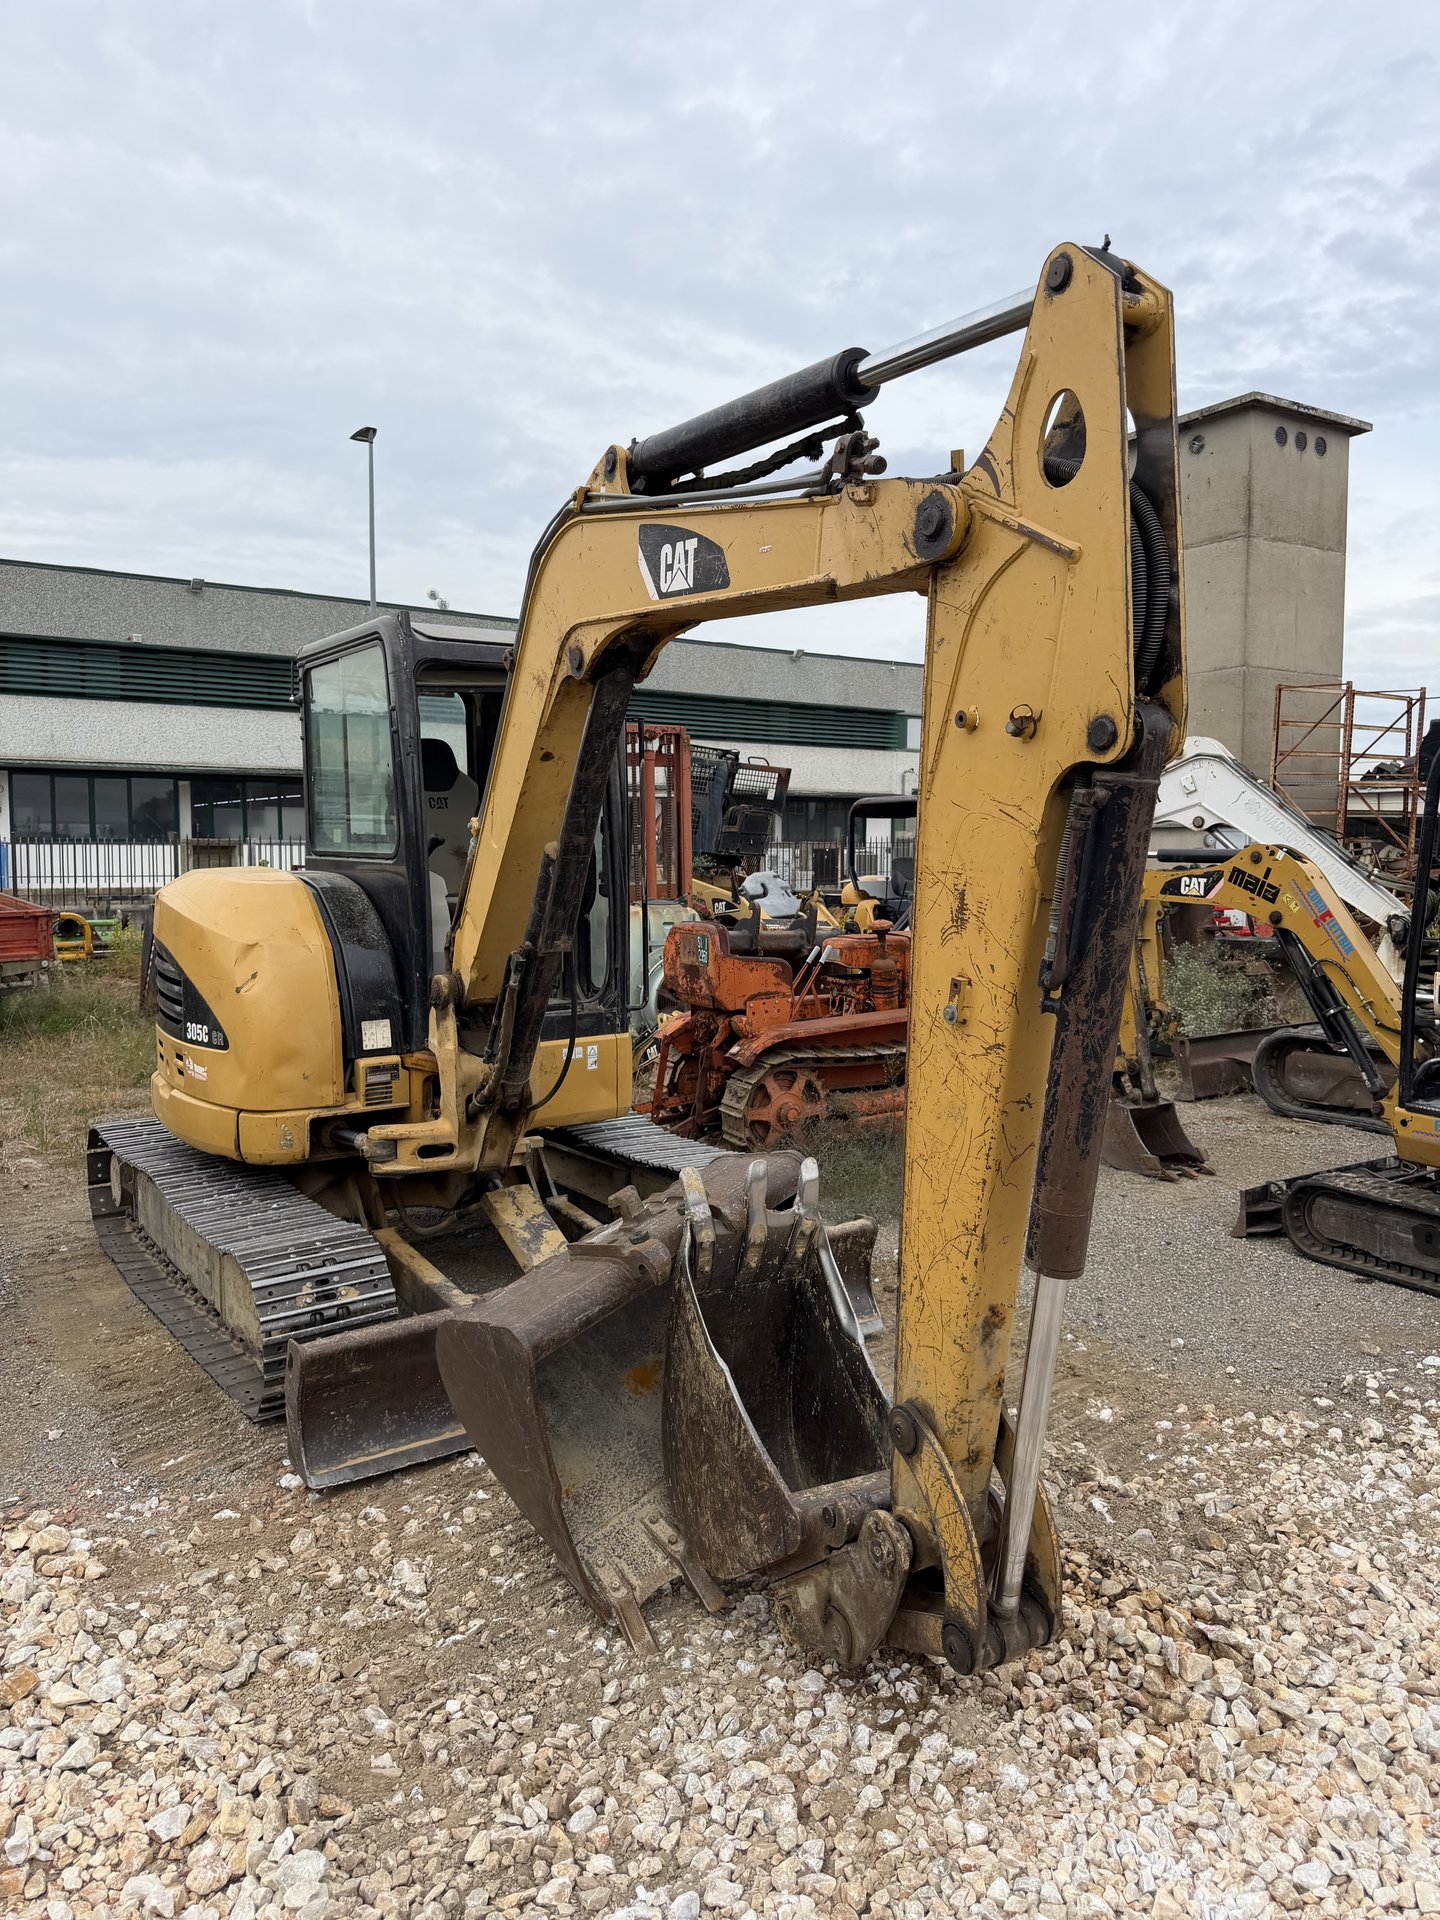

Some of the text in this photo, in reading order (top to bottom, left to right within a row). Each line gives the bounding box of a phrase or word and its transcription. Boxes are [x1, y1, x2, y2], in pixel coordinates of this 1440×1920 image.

[660, 537, 698, 593] CAT
[428, 797, 449, 809] CAT
[1180, 876, 1207, 897] CAT
[714, 901, 727, 914] CAT
[186, 1021, 209, 1043] 305C
[646, 1045, 659, 1061] CAT
